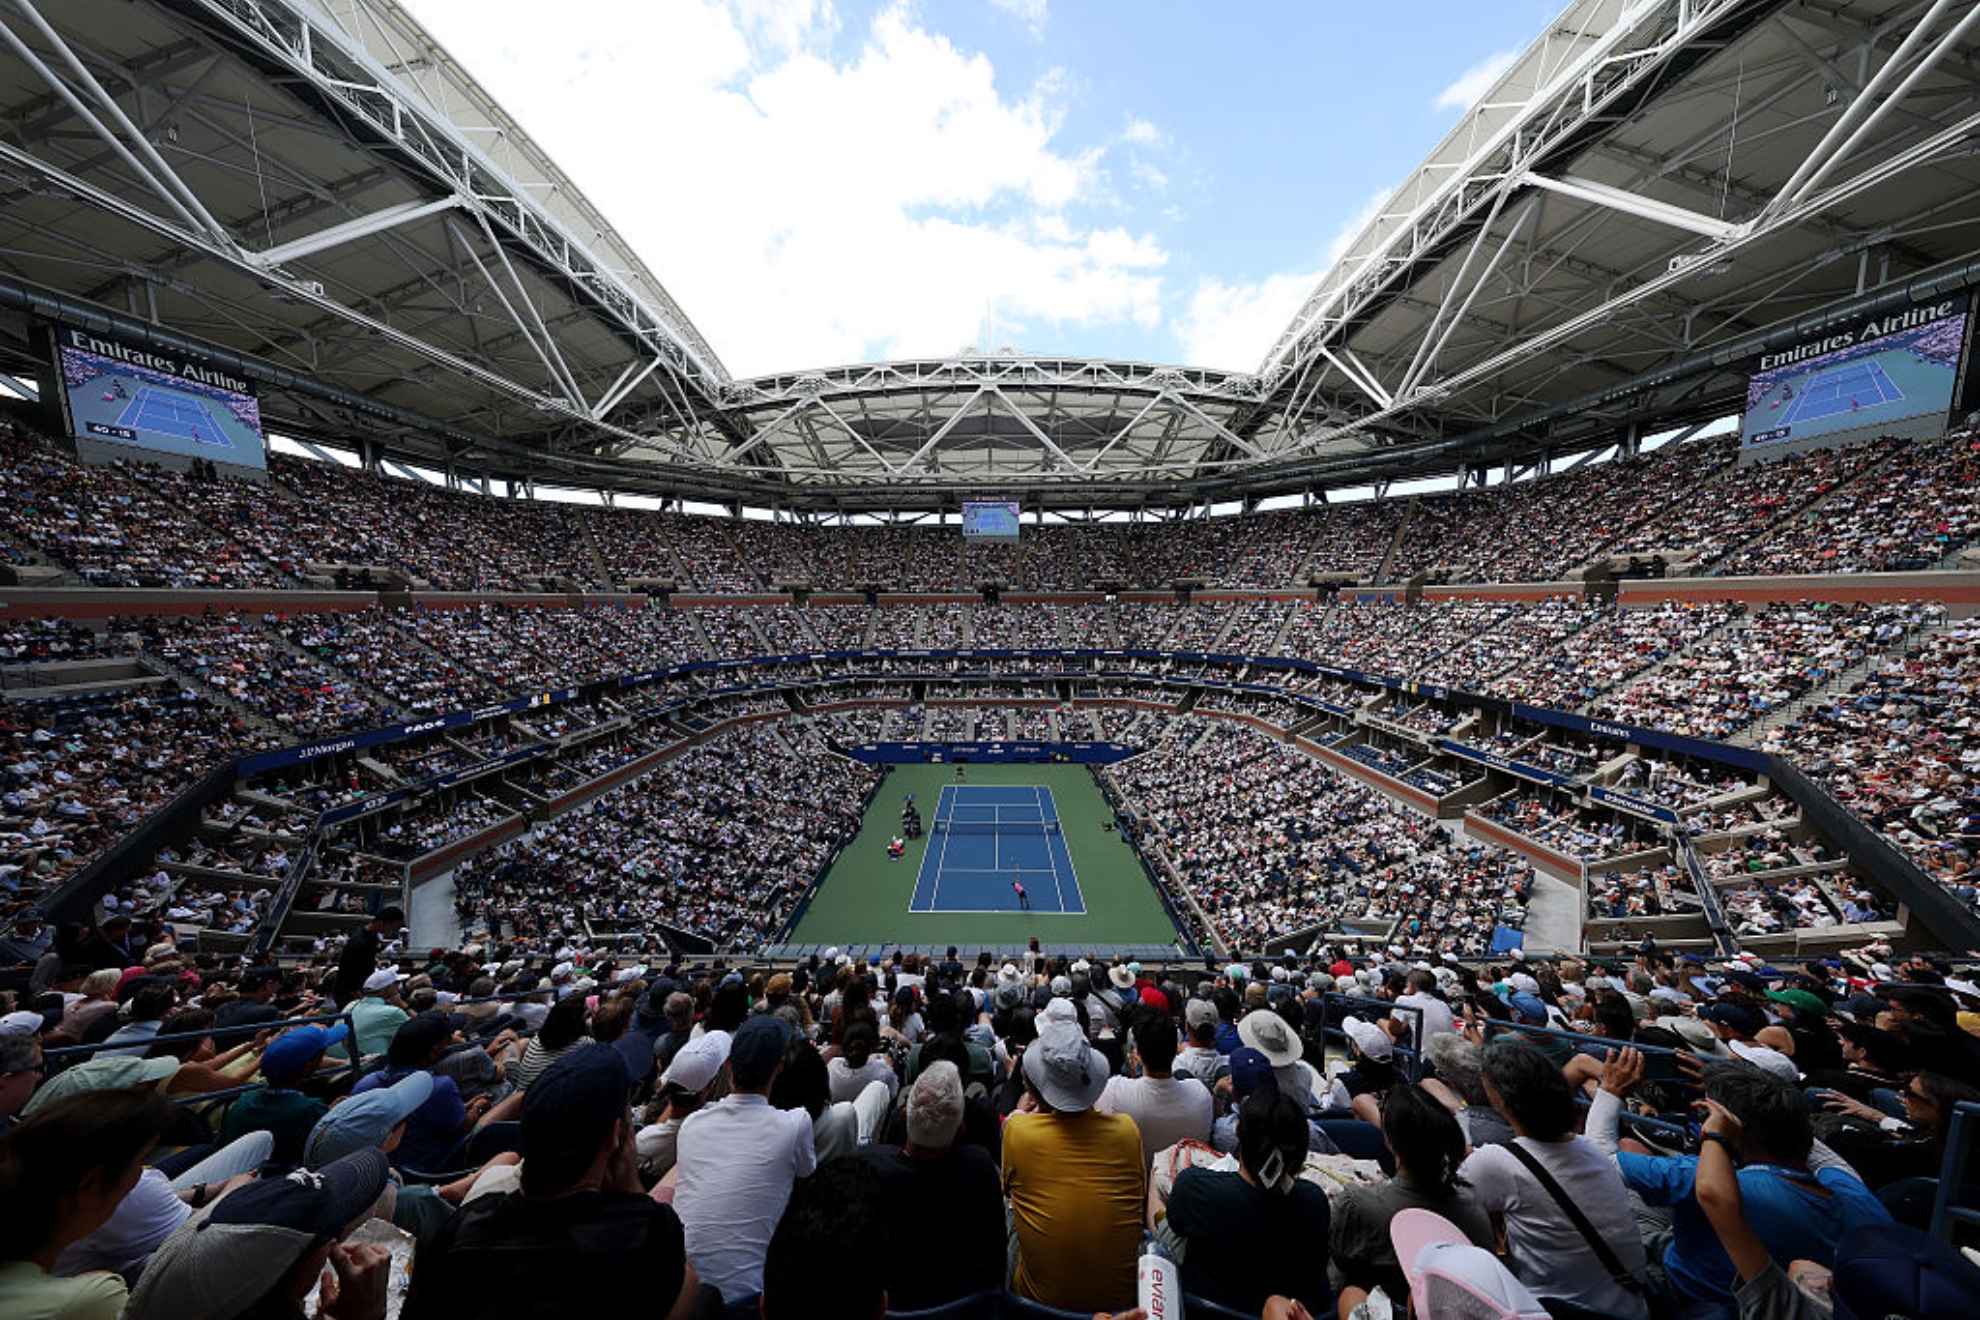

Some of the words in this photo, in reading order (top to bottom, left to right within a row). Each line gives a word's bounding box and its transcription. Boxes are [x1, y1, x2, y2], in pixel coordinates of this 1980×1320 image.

[70, 329, 177, 373] Emirates
[182, 362, 249, 395] Airline
[1760, 329, 1854, 372] Emirates
[1859, 300, 1953, 344] Airline
